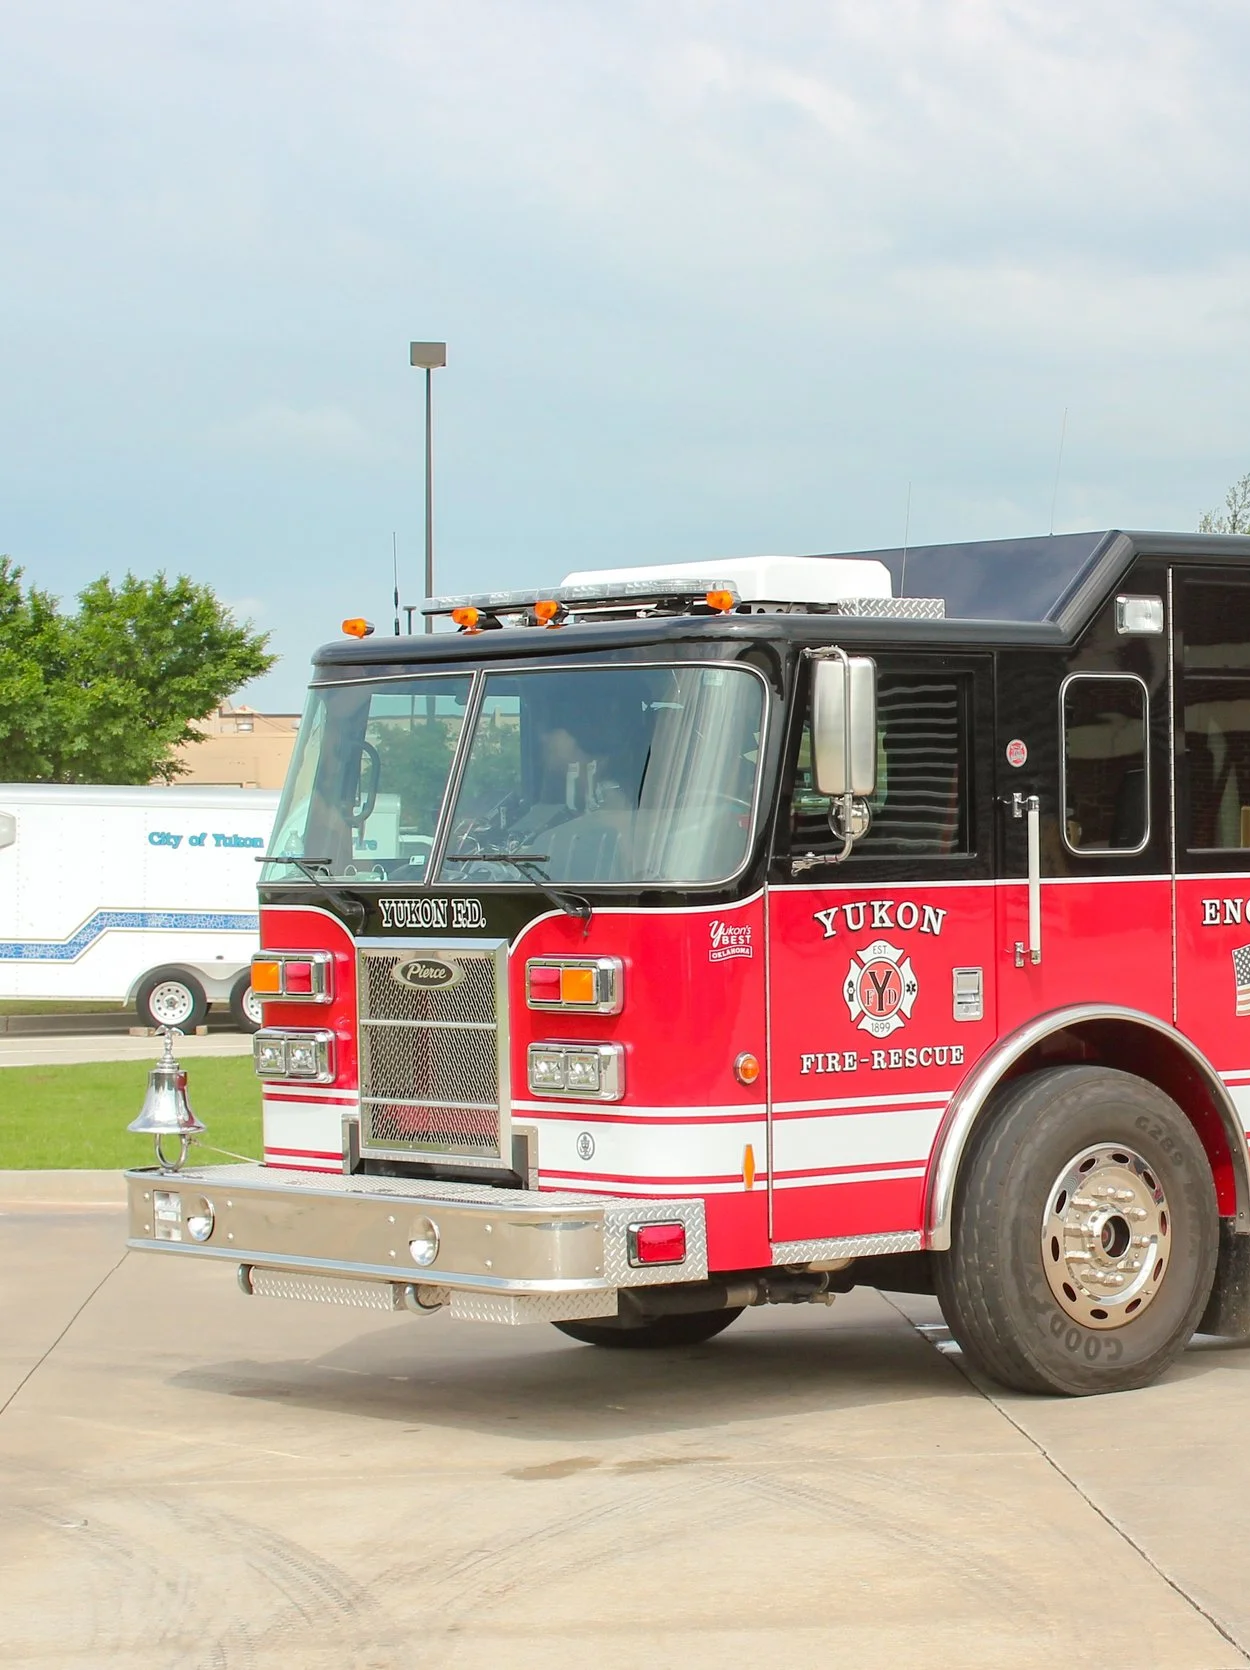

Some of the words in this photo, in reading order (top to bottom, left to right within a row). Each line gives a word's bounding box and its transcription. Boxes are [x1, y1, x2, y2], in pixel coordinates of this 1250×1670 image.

[148, 831, 183, 850] City
[189, 832, 206, 848] of
[212, 833, 264, 849] Yukon
[379, 898, 448, 928] YUKON
[452, 898, 487, 929] F.D.
[814, 900, 947, 938] YUKON
[709, 920, 752, 948] Yukon's
[721, 933, 752, 946] BEST
[710, 947, 751, 960] OKLAHOMA
[872, 945, 889, 955] EST.
[406, 963, 447, 981] Pierce
[870, 1022, 891, 1033] 1899
[800, 1045, 965, 1074] FIRE-RESCUE
